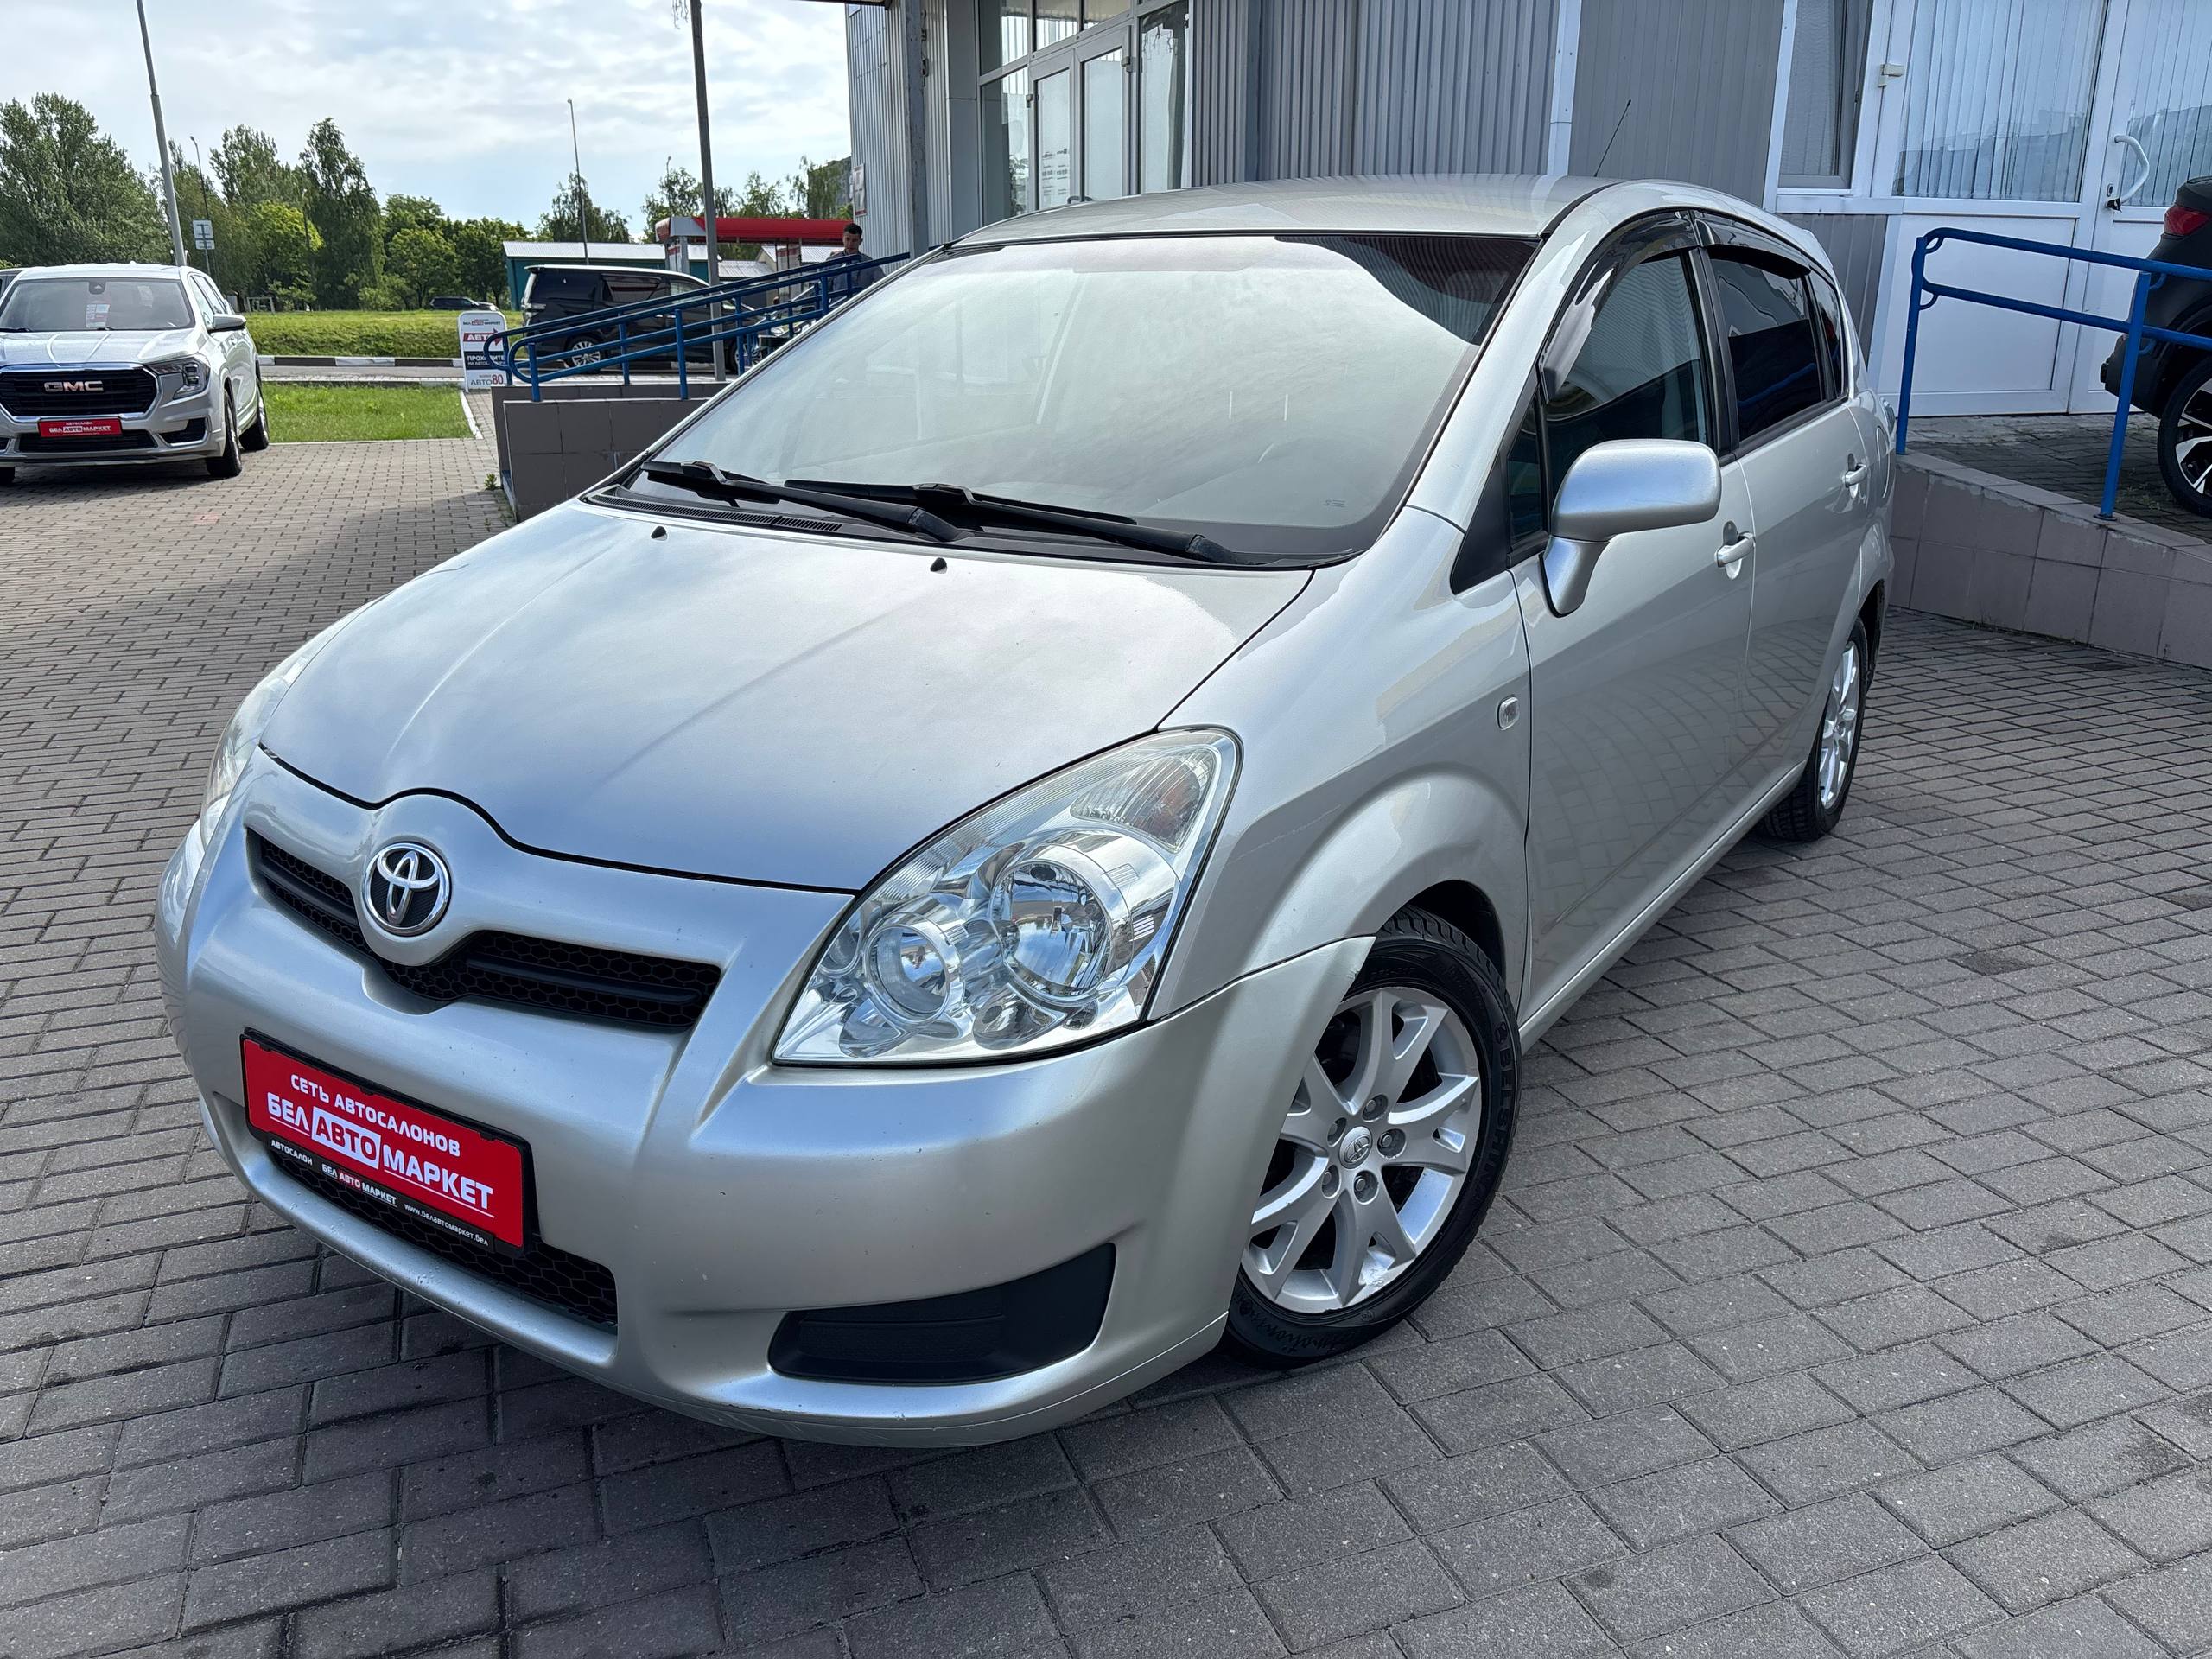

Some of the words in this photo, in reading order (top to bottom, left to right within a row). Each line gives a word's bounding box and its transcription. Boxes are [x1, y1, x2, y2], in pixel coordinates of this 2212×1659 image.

[44, 381, 104, 392] GMC
[290, 1074, 329, 1103] СЕТЬ
[334, 1094, 461, 1157] АВТОСАЛОНОВ
[270, 1139, 313, 1166] АВТОСАЛОН
[321, 1163, 338, 1178] БЕЛ
[339, 1173, 361, 1189] АВТО
[361, 1182, 397, 1205] МАРКЕТ
[404, 1204, 489, 1247] www.белавтомаркет.бел
